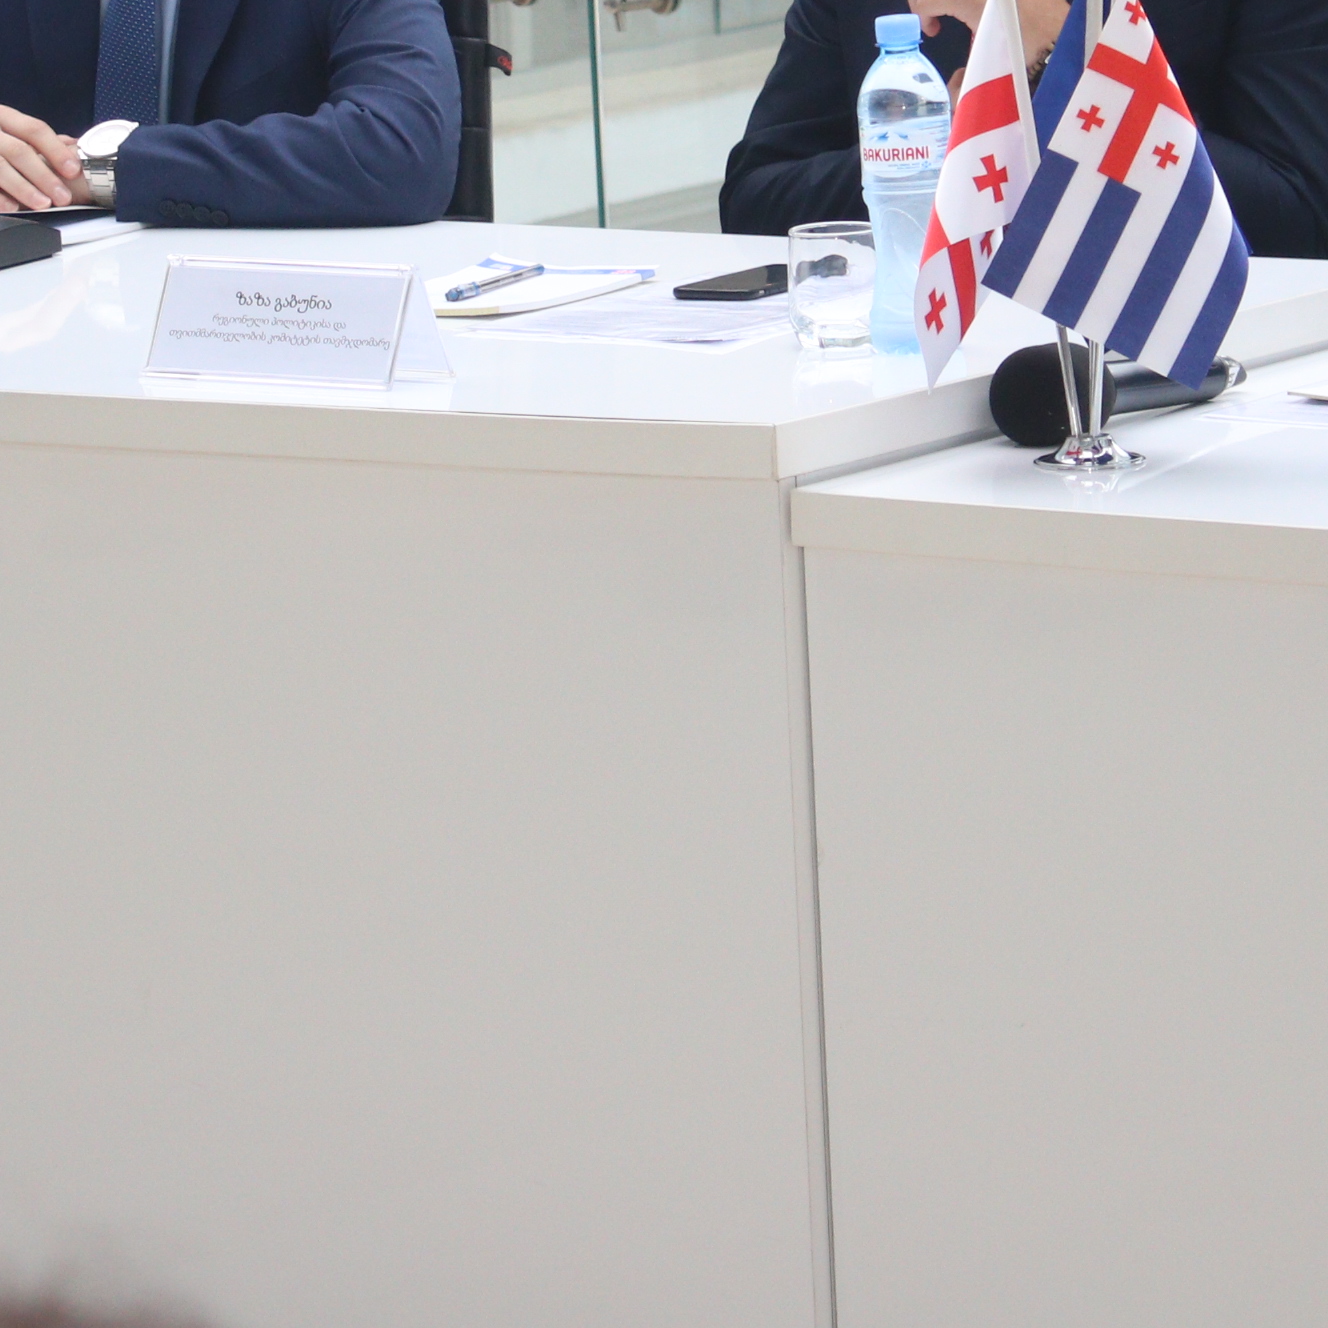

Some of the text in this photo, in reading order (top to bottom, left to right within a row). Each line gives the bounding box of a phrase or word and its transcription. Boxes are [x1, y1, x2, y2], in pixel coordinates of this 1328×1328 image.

[863, 145, 930, 162] BAKURIANI
[235, 291, 333, 313] ზაზა გაბუნია
[333, 320, 347, 331] და
